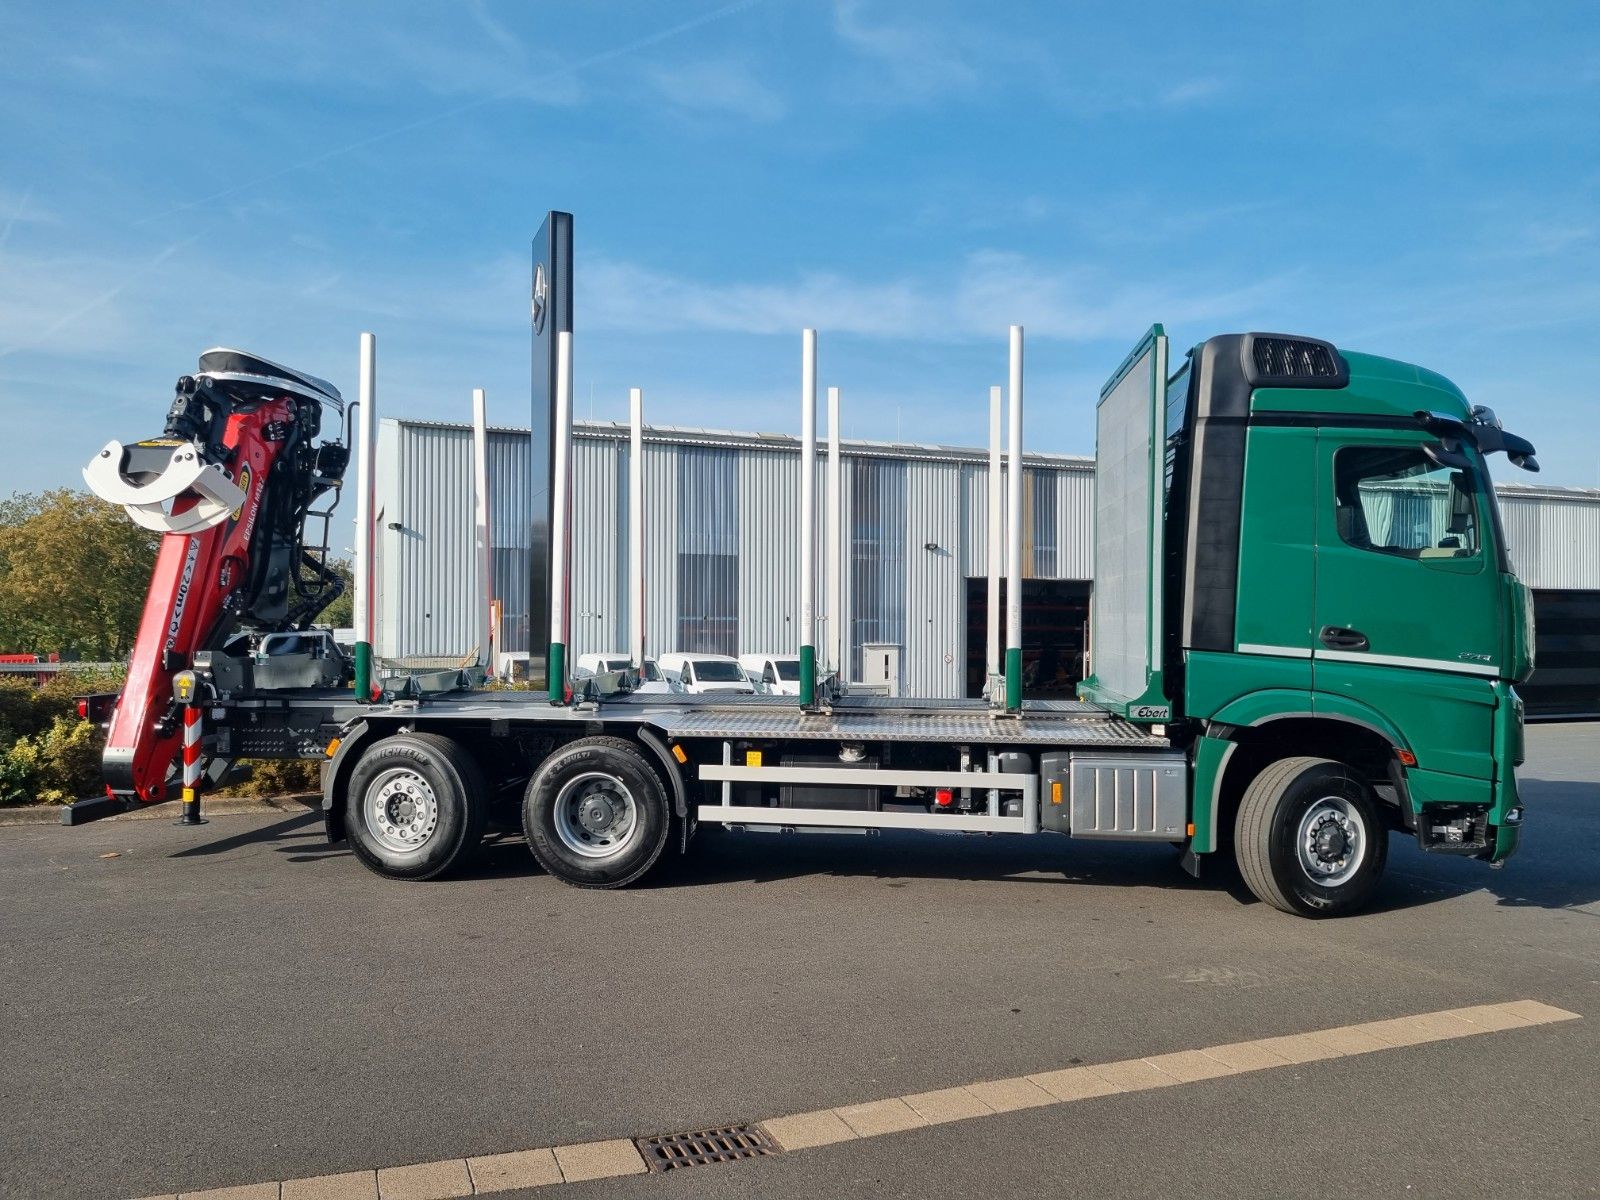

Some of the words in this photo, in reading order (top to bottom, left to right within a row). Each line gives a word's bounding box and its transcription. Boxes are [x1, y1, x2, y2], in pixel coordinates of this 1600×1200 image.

[243, 502, 259, 541] EPSILON
[1138, 706, 1168, 717] Ebert
[370, 747, 428, 763] MICHELIN
[564, 751, 591, 765] MULTI
